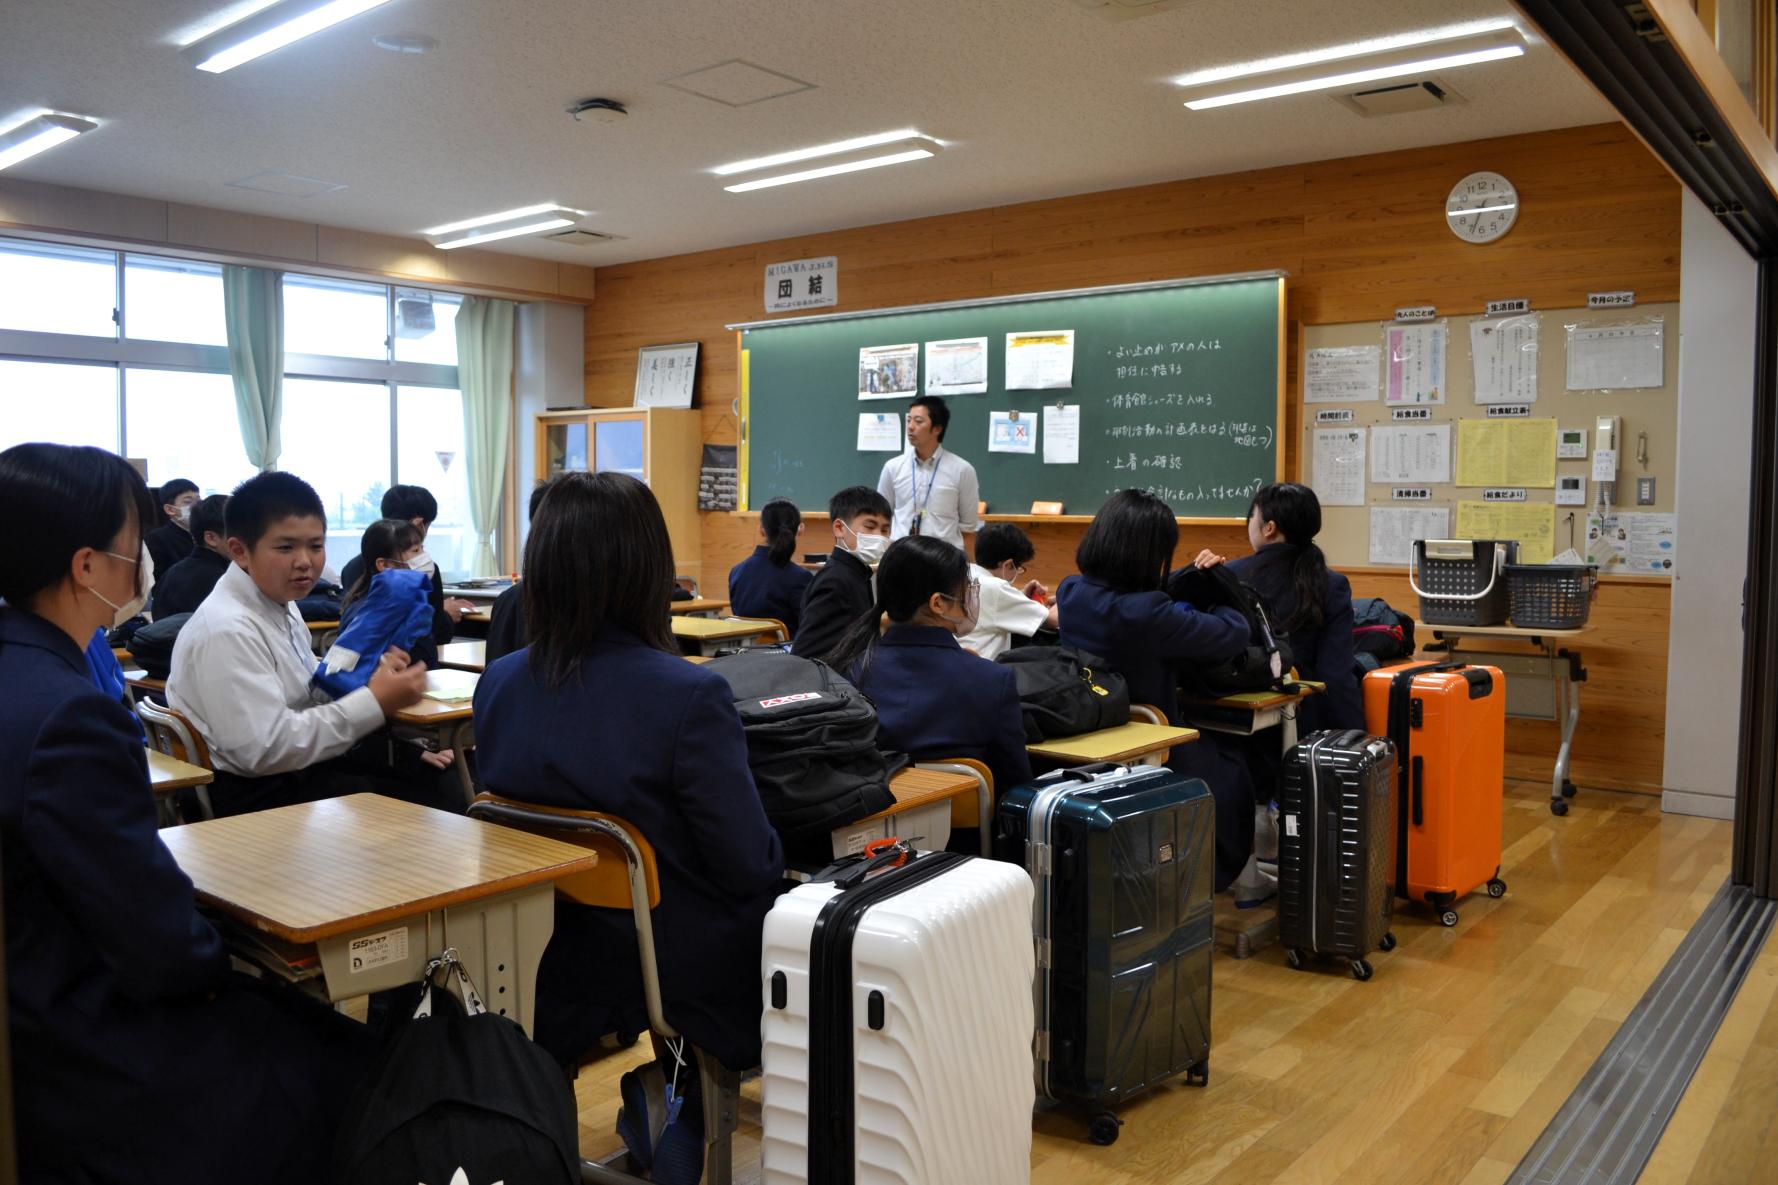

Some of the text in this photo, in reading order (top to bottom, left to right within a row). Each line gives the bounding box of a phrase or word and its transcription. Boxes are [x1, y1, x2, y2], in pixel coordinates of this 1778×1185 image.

[1467, 186, 1475, 194] 11
[1477, 181, 1487, 190] 12
[1459, 217, 1466, 225] 8
[1498, 213, 1505, 221] 4
[1478, 226, 1485, 234] 6
[1490, 222, 1497, 231] 5
[778, 274, 823, 299] 団結
[1591, 295, 1631, 304] 今月の予定
[1490, 301, 1524, 312] 生活目標
[1396, 410, 1427, 419] 給食当番
[1490, 406, 1526, 415] 給食献立表
[1397, 489, 1427, 498] 清掃当番
